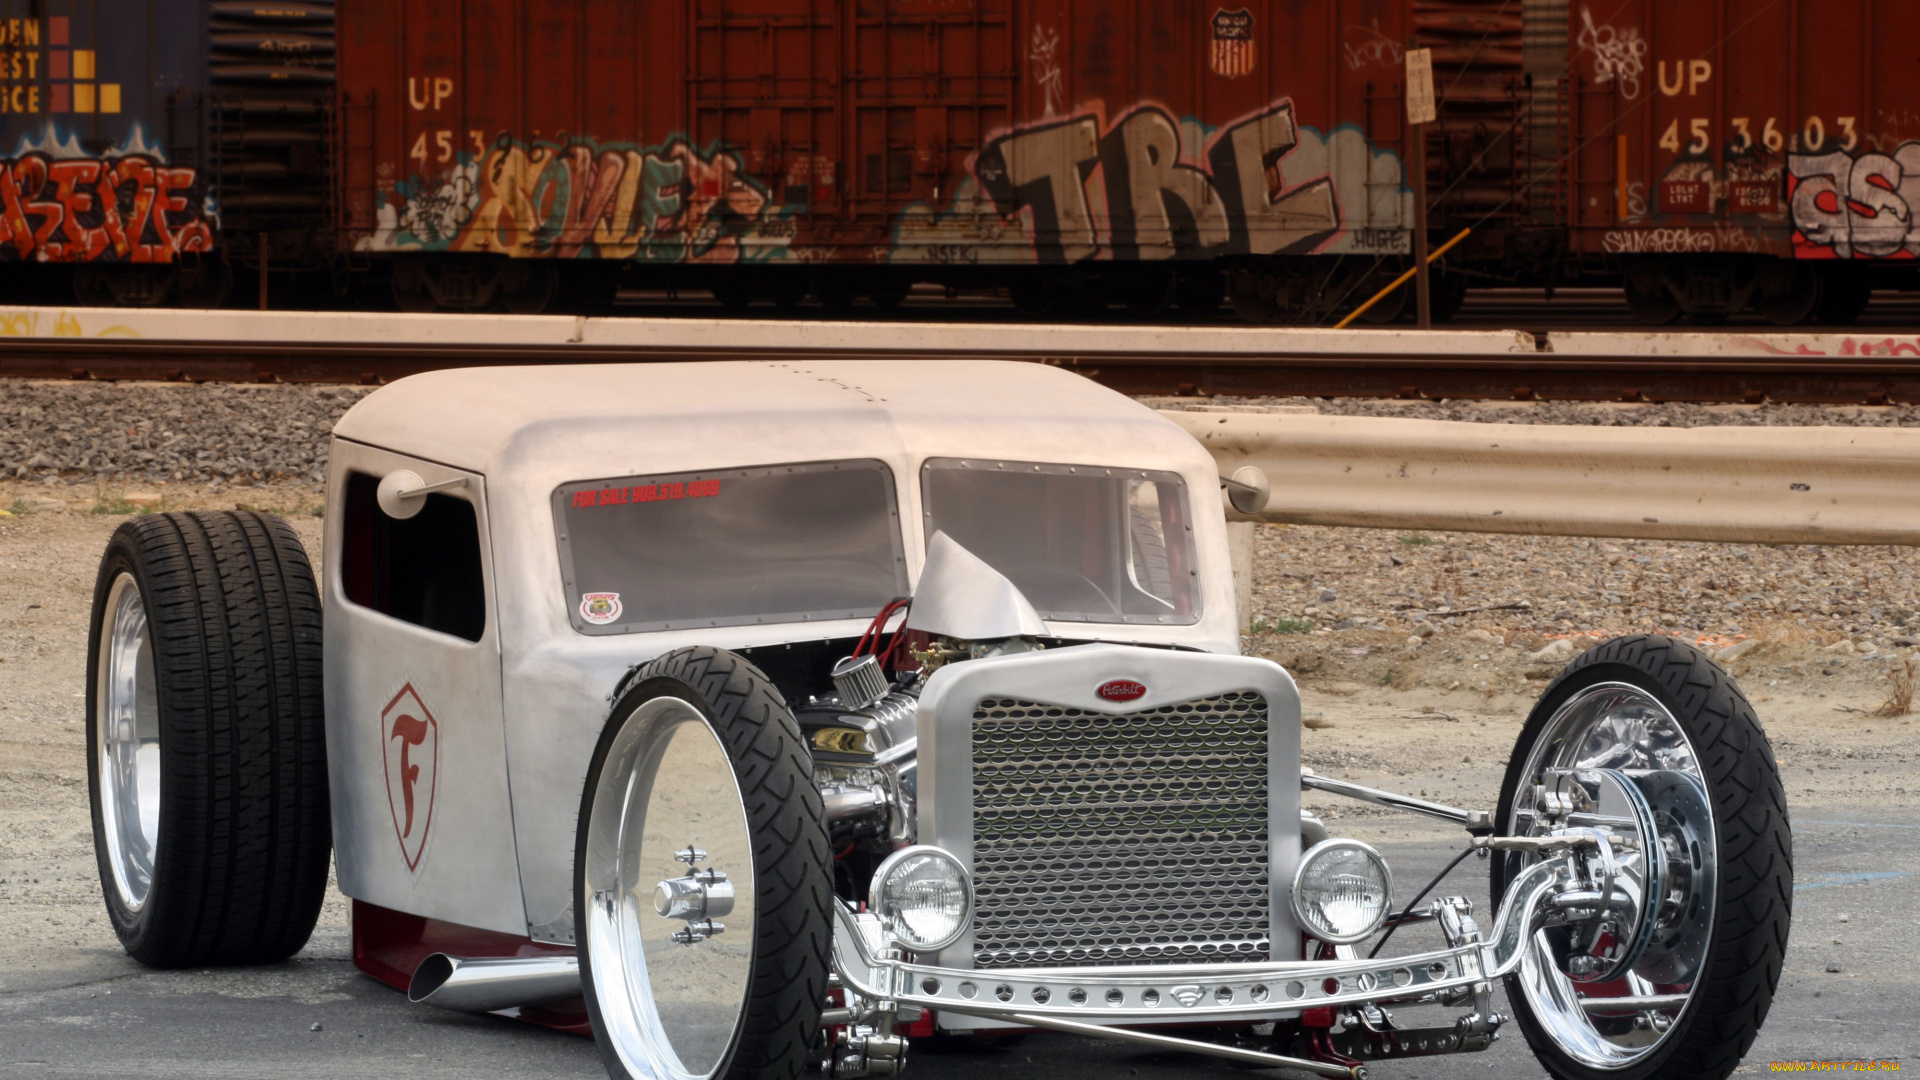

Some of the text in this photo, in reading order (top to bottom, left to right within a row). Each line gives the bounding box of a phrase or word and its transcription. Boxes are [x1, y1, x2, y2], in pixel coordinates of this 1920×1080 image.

[1658, 60, 1712, 96] UP
[409, 77, 453, 110] UP
[572, 490, 597, 508] FOR
[599, 486, 630, 506] SALE
[1102, 683, 1142, 696] Peterbilt
